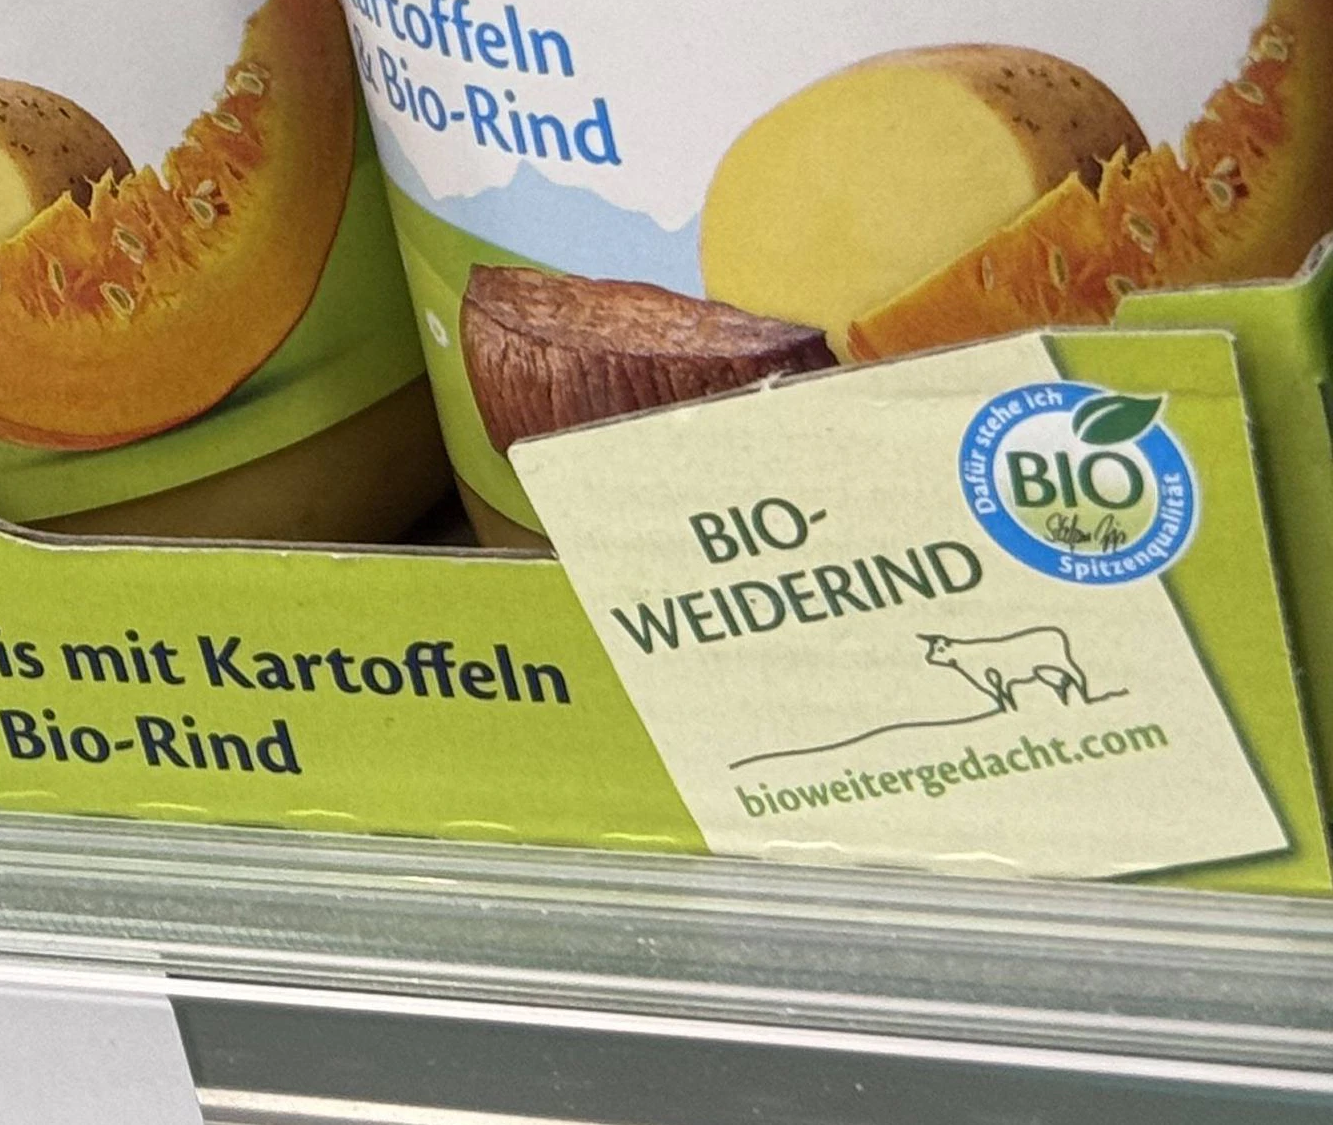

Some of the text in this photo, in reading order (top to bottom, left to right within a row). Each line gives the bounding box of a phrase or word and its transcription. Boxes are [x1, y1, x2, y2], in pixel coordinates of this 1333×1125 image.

[376, 46, 622, 166] Bio-Rind
[964, 386, 1064, 515] Dafür stehe ich
[1005, 450, 1145, 510] BIO
[687, 495, 831, 566] BIO-
[1058, 472, 1185, 580] Spitzenqualität
[608, 539, 984, 657] WEIDERIND
[57, 628, 187, 686] mit
[195, 633, 573, 706] Kartoffeln
[735, 717, 1170, 821] bioweitergedacht.com
